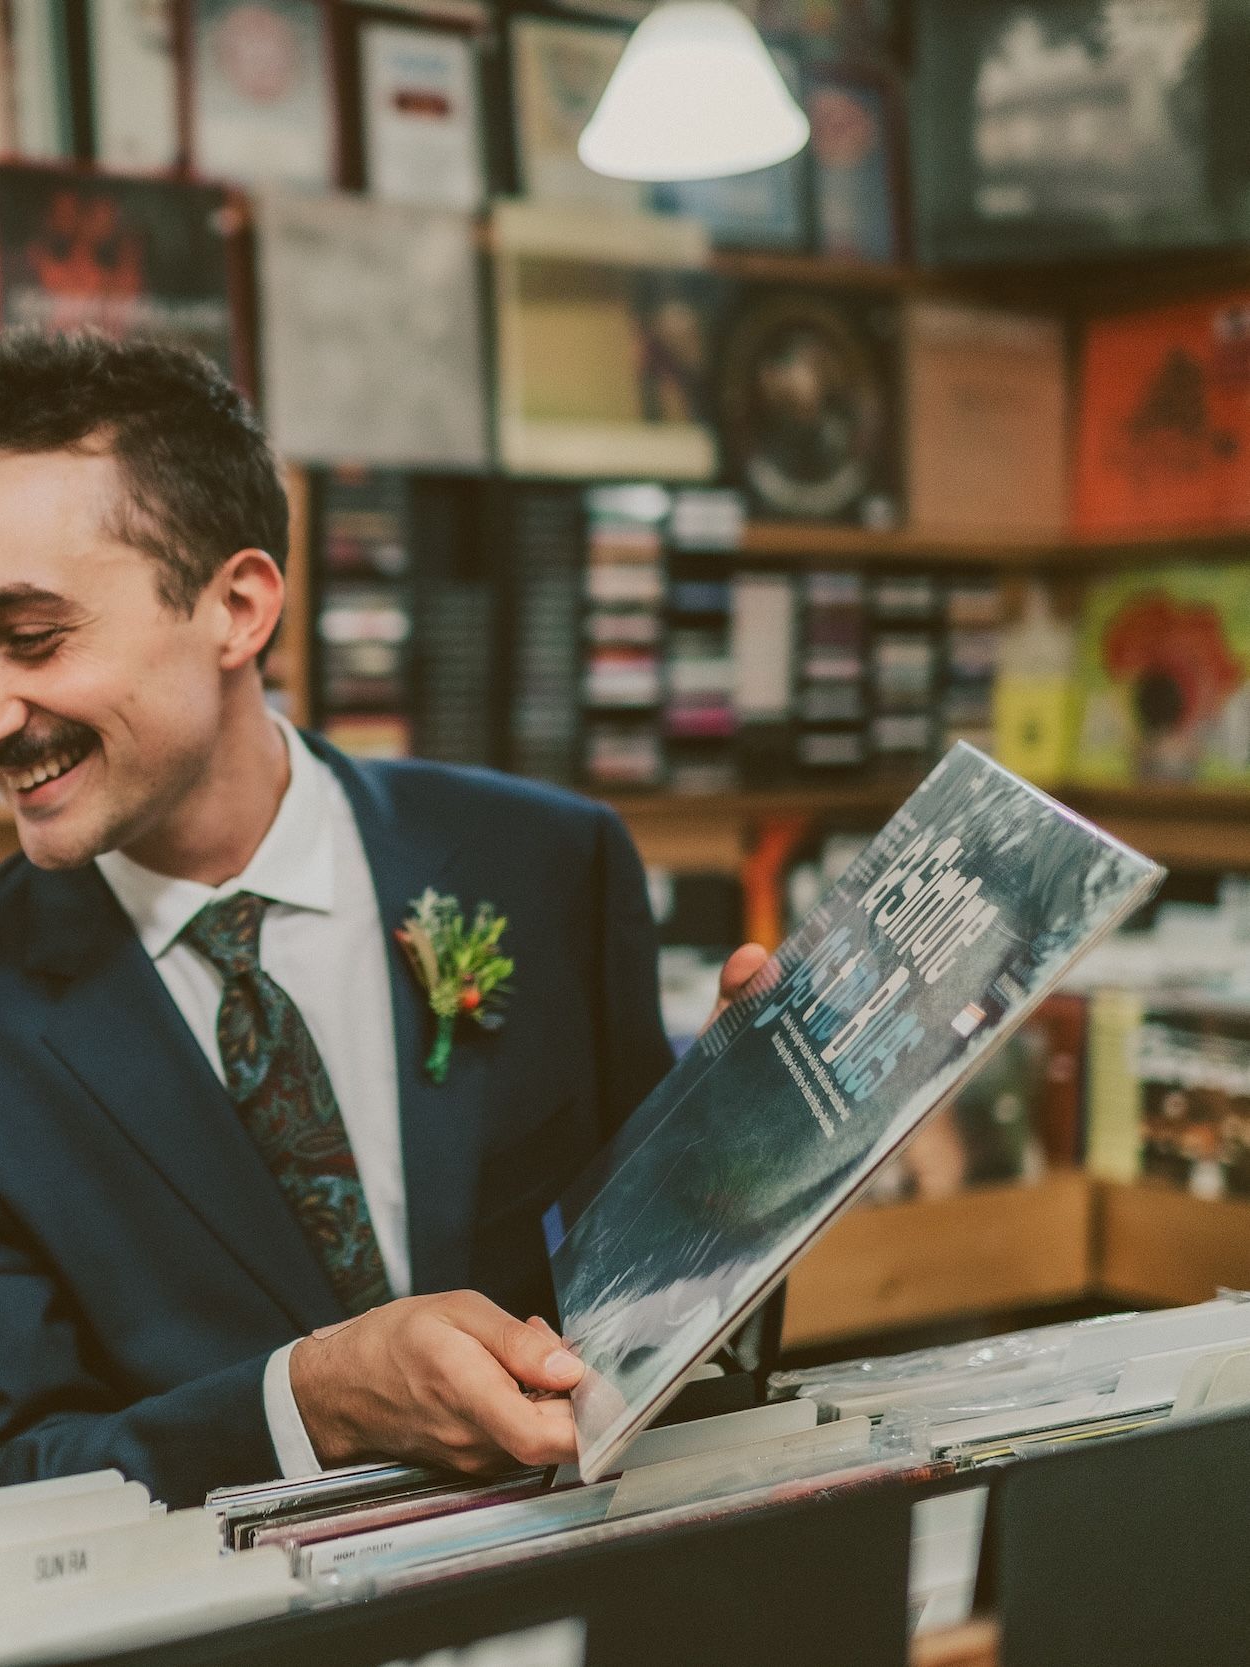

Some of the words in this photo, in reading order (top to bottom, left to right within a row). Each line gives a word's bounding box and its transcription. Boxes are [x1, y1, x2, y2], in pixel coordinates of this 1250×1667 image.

[874, 836, 1000, 984] Simone
[802, 948, 880, 1042] the
[820, 965, 926, 1102] Blues
[35, 1554, 64, 1582] SUN
[333, 1549, 356, 1562] HIGH
[359, 1541, 393, 1555] DELITY
